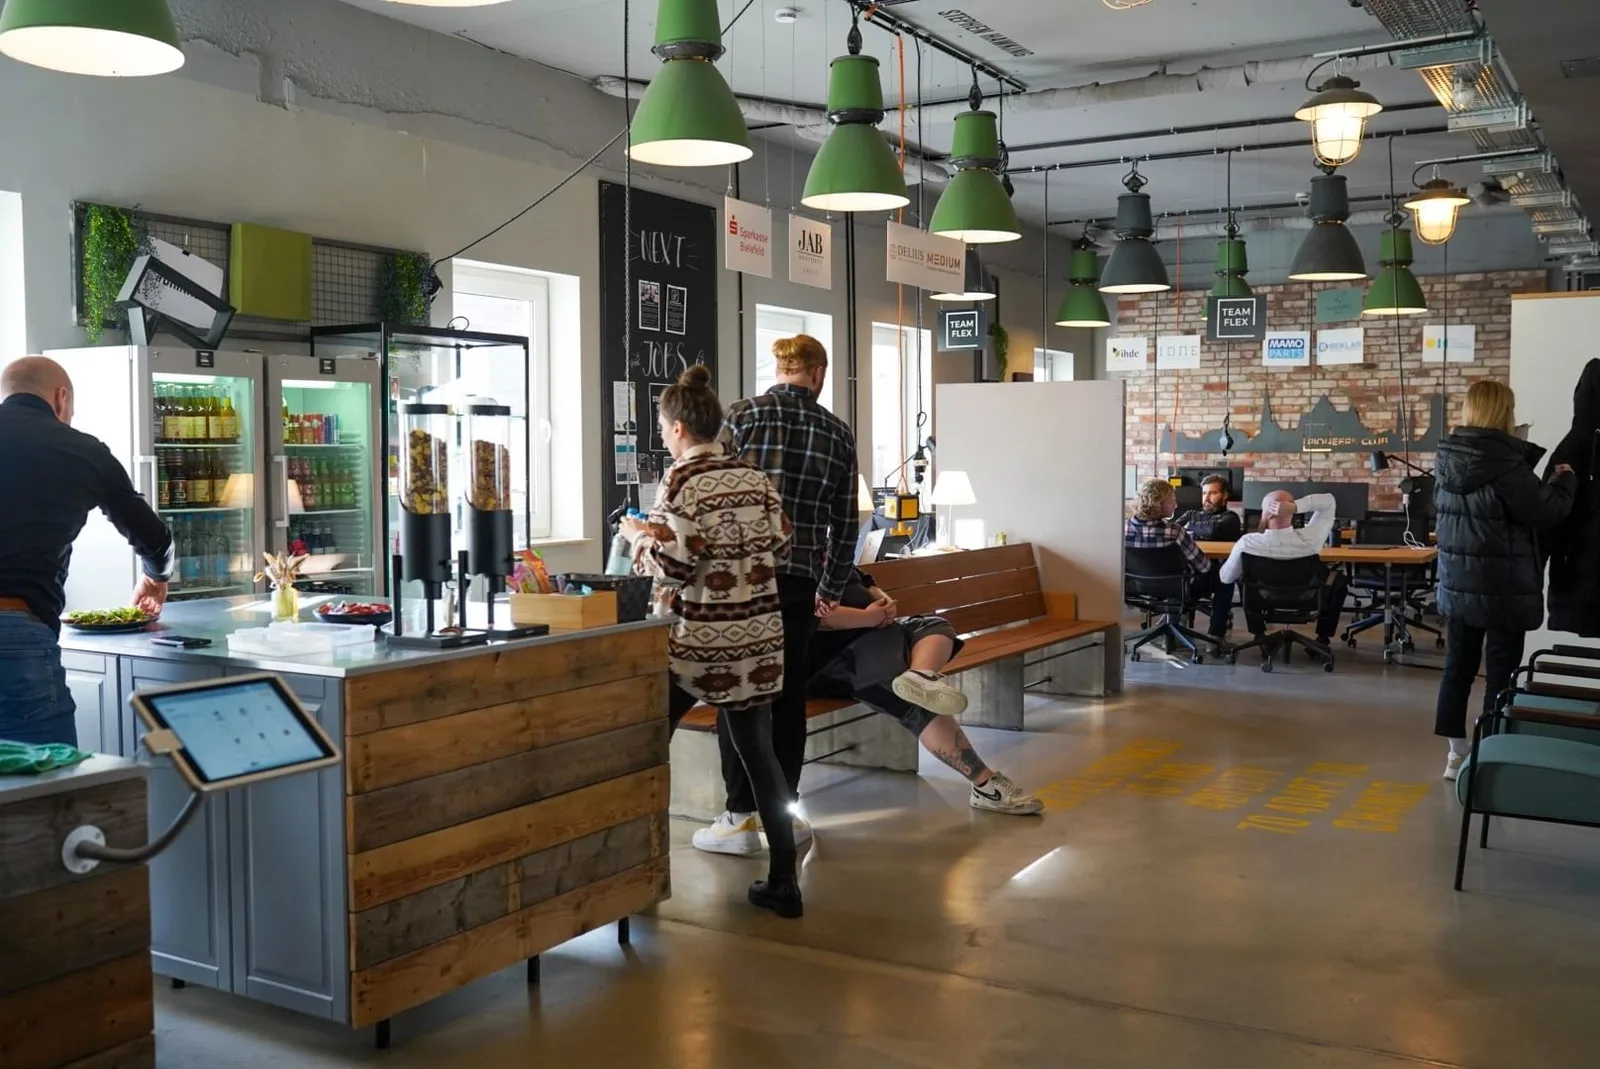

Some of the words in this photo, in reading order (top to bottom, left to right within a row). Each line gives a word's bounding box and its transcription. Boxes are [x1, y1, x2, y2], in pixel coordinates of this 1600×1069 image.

[938, 9, 995, 34] STEPHEN
[740, 227, 768, 243] Sparkasse
[798, 230, 823, 254] JAB
[641, 229, 686, 268] NEXT
[740, 242, 764, 256] Bielefeld
[897, 244, 924, 261] DELIUS
[926, 252, 961, 270] MEDIUM
[1221, 307, 1251, 317] TEAM
[949, 319, 974, 329] TEAM
[1223, 317, 1249, 327] FLEX
[951, 329, 972, 338] FLEX
[1269, 339, 1304, 349] MAMO
[642, 341, 687, 379] JOBS
[1269, 349, 1304, 358] PARTS
